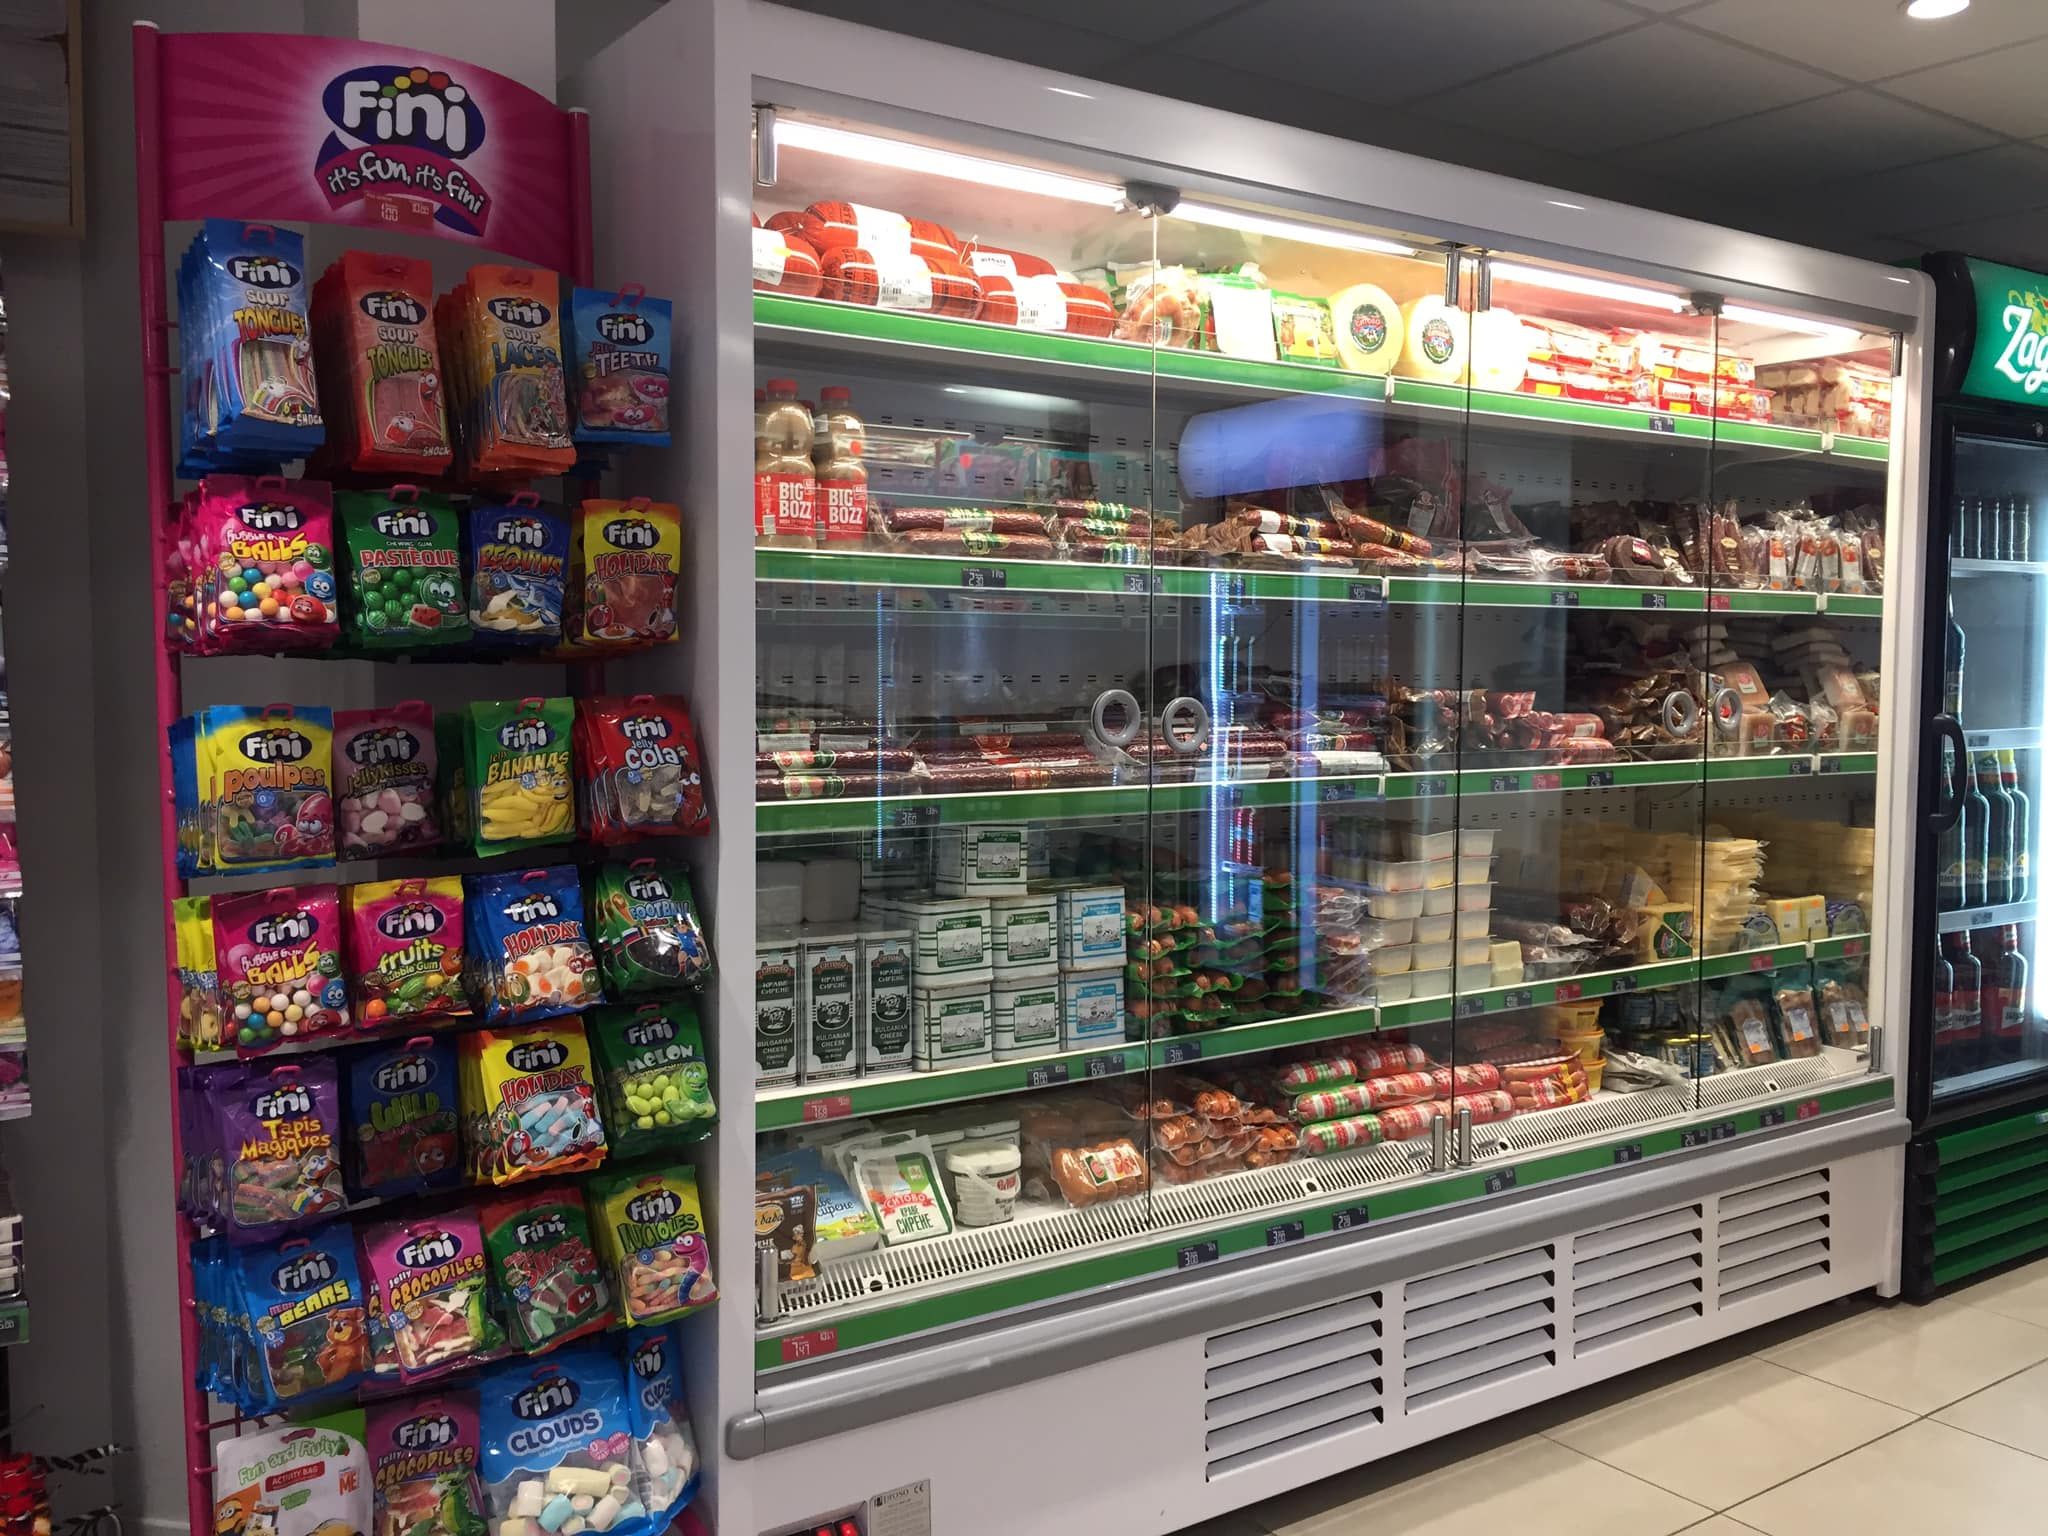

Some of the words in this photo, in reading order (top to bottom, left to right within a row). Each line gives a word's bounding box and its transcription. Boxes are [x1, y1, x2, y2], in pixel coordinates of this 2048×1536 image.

[343, 80, 466, 152] Fini
[328, 167, 361, 193] it's
[359, 152, 411, 185] fun,
[416, 165, 444, 191] it's
[445, 171, 484, 214] fini
[234, 261, 291, 284] Fini
[367, 297, 420, 322] Fini
[494, 300, 542, 325] Fini
[233, 308, 306, 343] TONGUES
[601, 317, 645, 342] Fini
[367, 348, 433, 378] TONGUES
[492, 343, 560, 373] LACES
[595, 351, 659, 376] TEETH
[779, 482, 804, 501] BIG
[828, 488, 853, 506] BIG
[241, 506, 298, 528] Fini
[378, 512, 430, 536] Fini
[779, 501, 812, 519] BOZZ
[828, 507, 863, 525] BOZZ
[231, 533, 309, 562] BALLS
[498, 520, 544, 548] Fini
[608, 523, 653, 546] Fini
[594, 552, 672, 580] HOLIDAY
[502, 721, 547, 748] Fini
[623, 716, 667, 739] Fini
[246, 732, 301, 760] Fini
[352, 731, 411, 763] Fini
[487, 751, 569, 785] BANANAS
[223, 761, 325, 805] poulpes
[629, 879, 669, 899] Fini
[385, 904, 435, 936] Fini
[503, 896, 558, 923] Fini
[255, 912, 313, 944] Fini
[503, 921, 581, 960] HOLIDAY
[246, 941, 321, 986] BALLS
[378, 938, 445, 974] fruits
[629, 1018, 673, 1044] Fini
[816, 1032, 850, 1042] BULGARIAN
[875, 1024, 908, 1033] BULGARIAN
[880, 1032, 904, 1040] CHEESE
[513, 1043, 561, 1069] Fini
[757, 1038, 793, 1048] BULGARIAN
[763, 1046, 788, 1054] CHEESE
[821, 1040, 846, 1048] CHEESE
[378, 1057, 428, 1090] Fini
[501, 1065, 584, 1108] HOLIDAY
[256, 1086, 310, 1118] Fini
[370, 1092, 441, 1133] WILD
[262, 1117, 321, 1142] Tapis
[239, 1133, 332, 1161] Magiques
[630, 1191, 676, 1221] Fini
[900, 1205, 920, 1217] КРАВЕ
[516, 1214, 566, 1244] Fini
[895, 1214, 933, 1235] СИРЕНЕ
[403, 1232, 455, 1265] Fini
[278, 1253, 332, 1292] Fini
[390, 1254, 485, 1310] CROCODILES
[280, 1280, 350, 1327] BEARS
[518, 1377, 574, 1416] Fini
[399, 1416, 450, 1447] Fini
[510, 1411, 600, 1453] CLOUDS
[238, 1461, 266, 1485] Fun
[268, 1442, 296, 1468] and
[272, 1471, 301, 1486] ACTIVITY
[302, 1465, 319, 1476] BAG
[376, 1446, 474, 1490] CROCODILES
